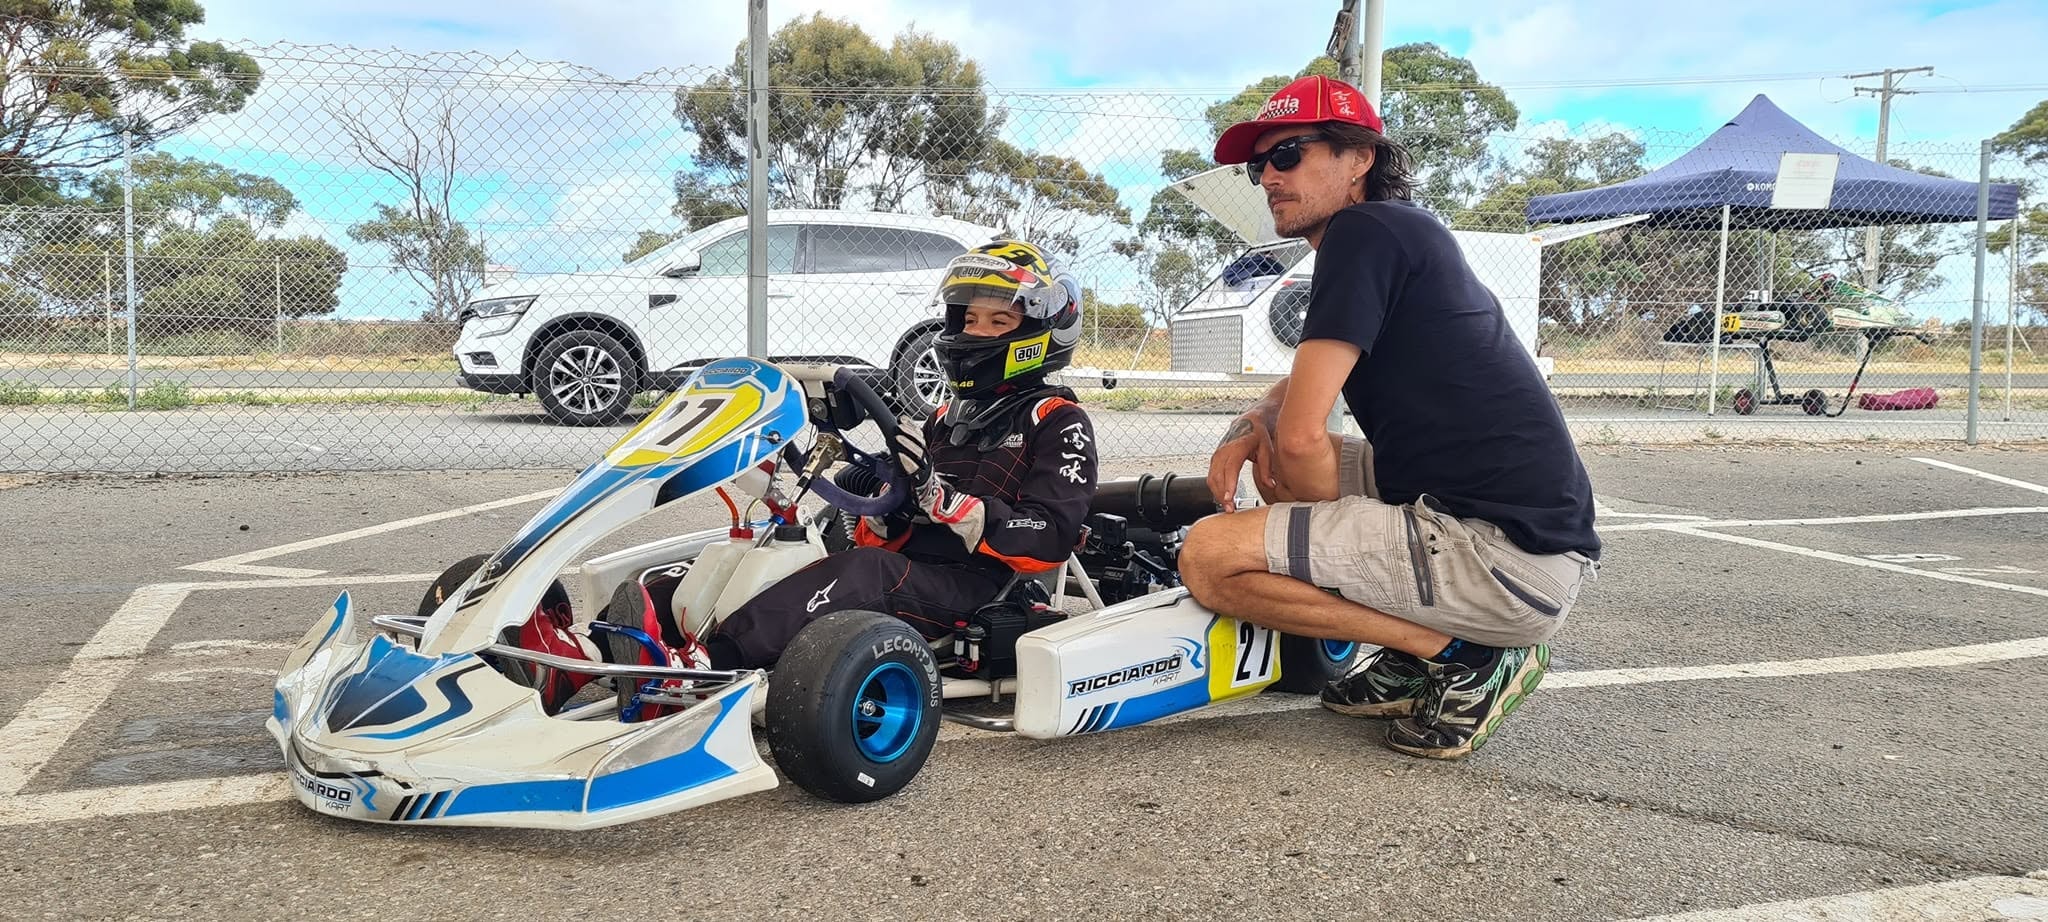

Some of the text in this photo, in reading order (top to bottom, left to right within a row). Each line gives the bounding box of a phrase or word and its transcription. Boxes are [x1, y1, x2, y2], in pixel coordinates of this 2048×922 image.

[1236, 621, 1274, 681] 27
[1069, 654, 1184, 696] RICCIARDO
[1152, 671, 1181, 686] KART
